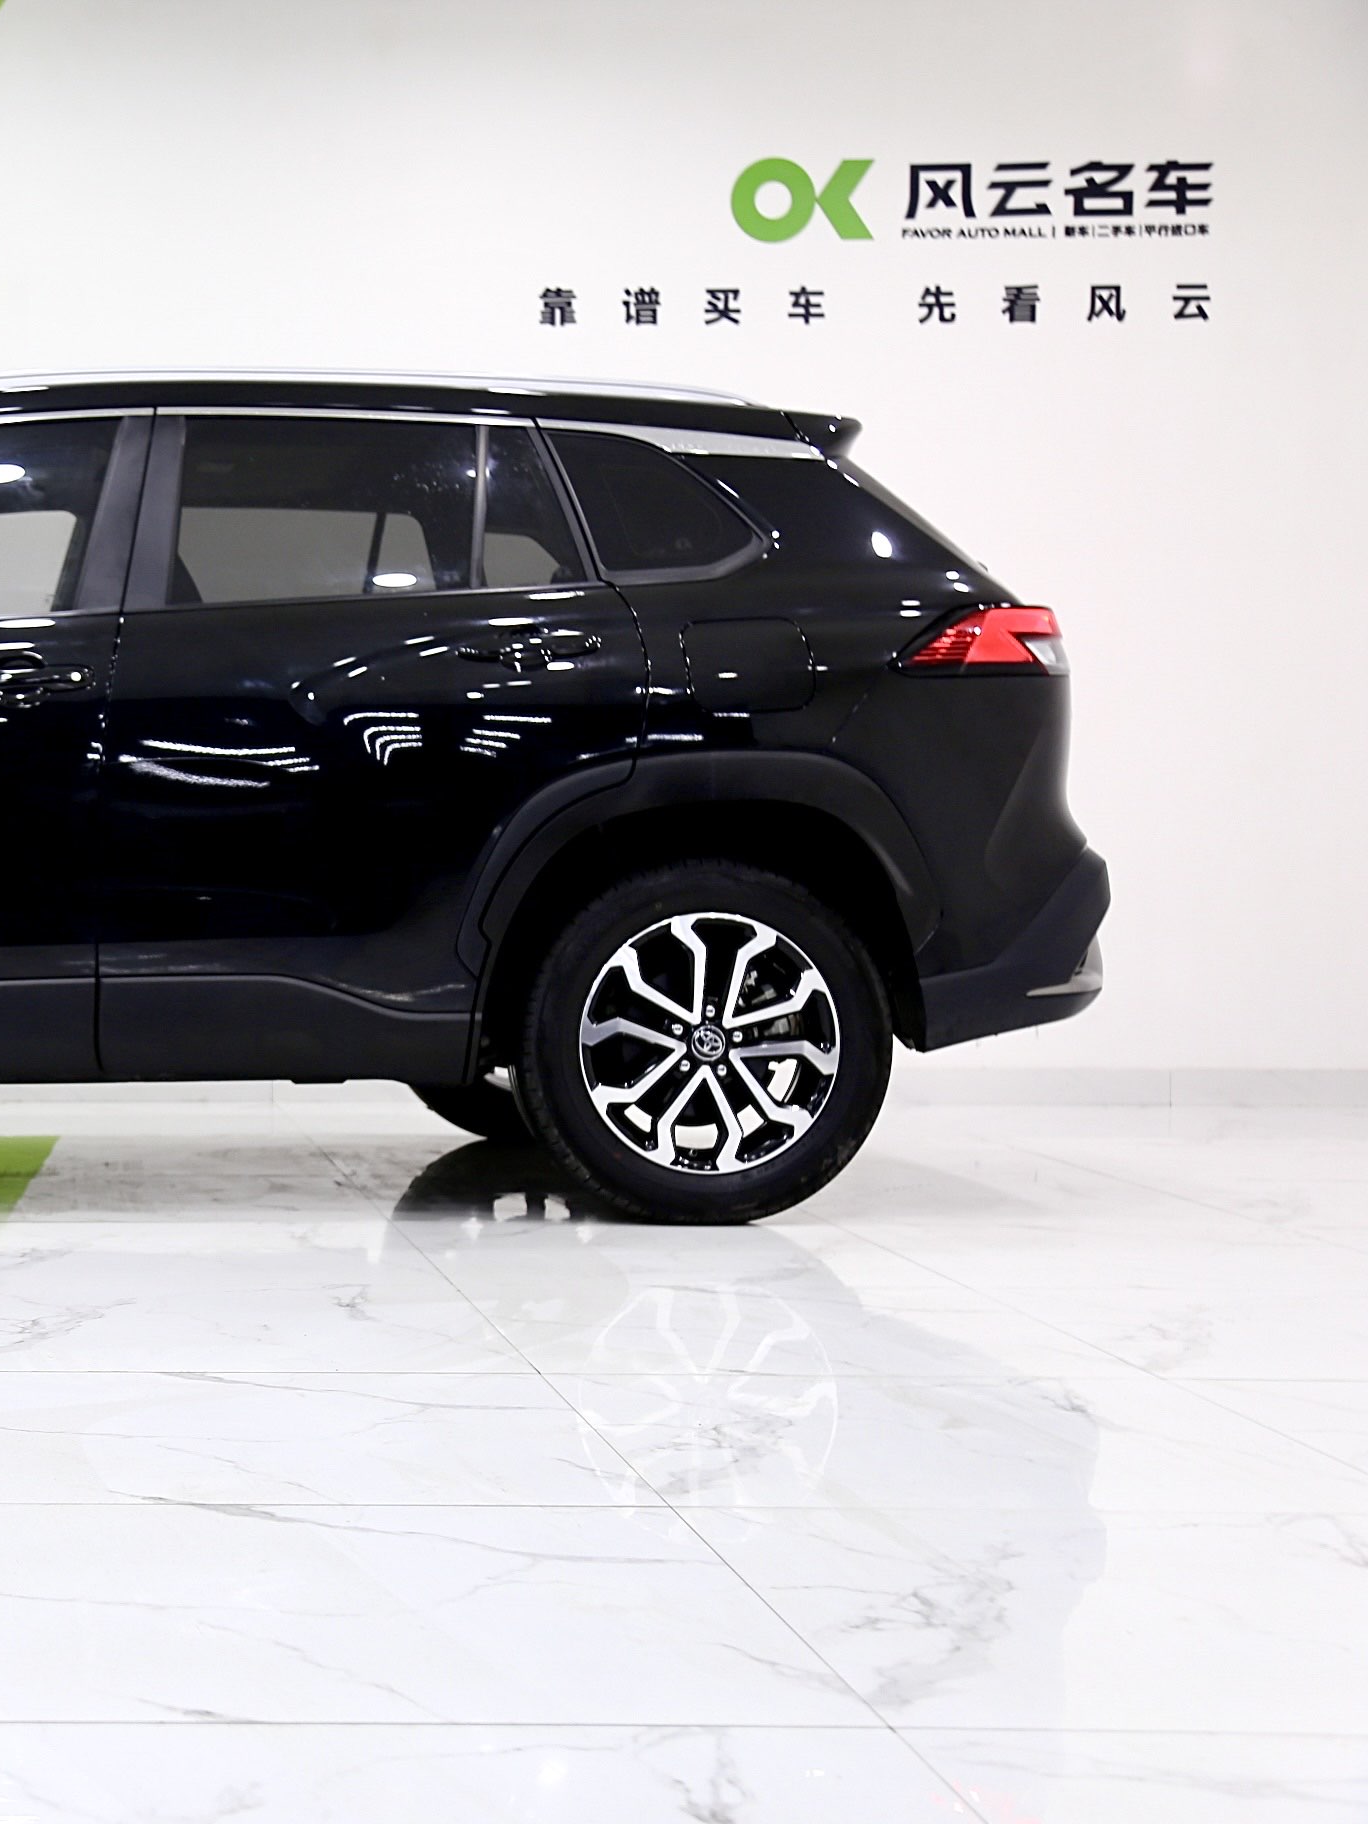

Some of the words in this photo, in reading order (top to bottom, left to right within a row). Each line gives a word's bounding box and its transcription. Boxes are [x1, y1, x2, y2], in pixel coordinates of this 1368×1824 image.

[730, 157, 874, 242] OK
[904, 160, 1214, 220] 风云名车
[901, 226, 953, 240] FAVOR
[957, 226, 1000, 239] AUTO
[1003, 225, 1047, 238] MALL
[538, 285, 826, 327] 靠谱买车
[917, 283, 1212, 325] 先看风云
